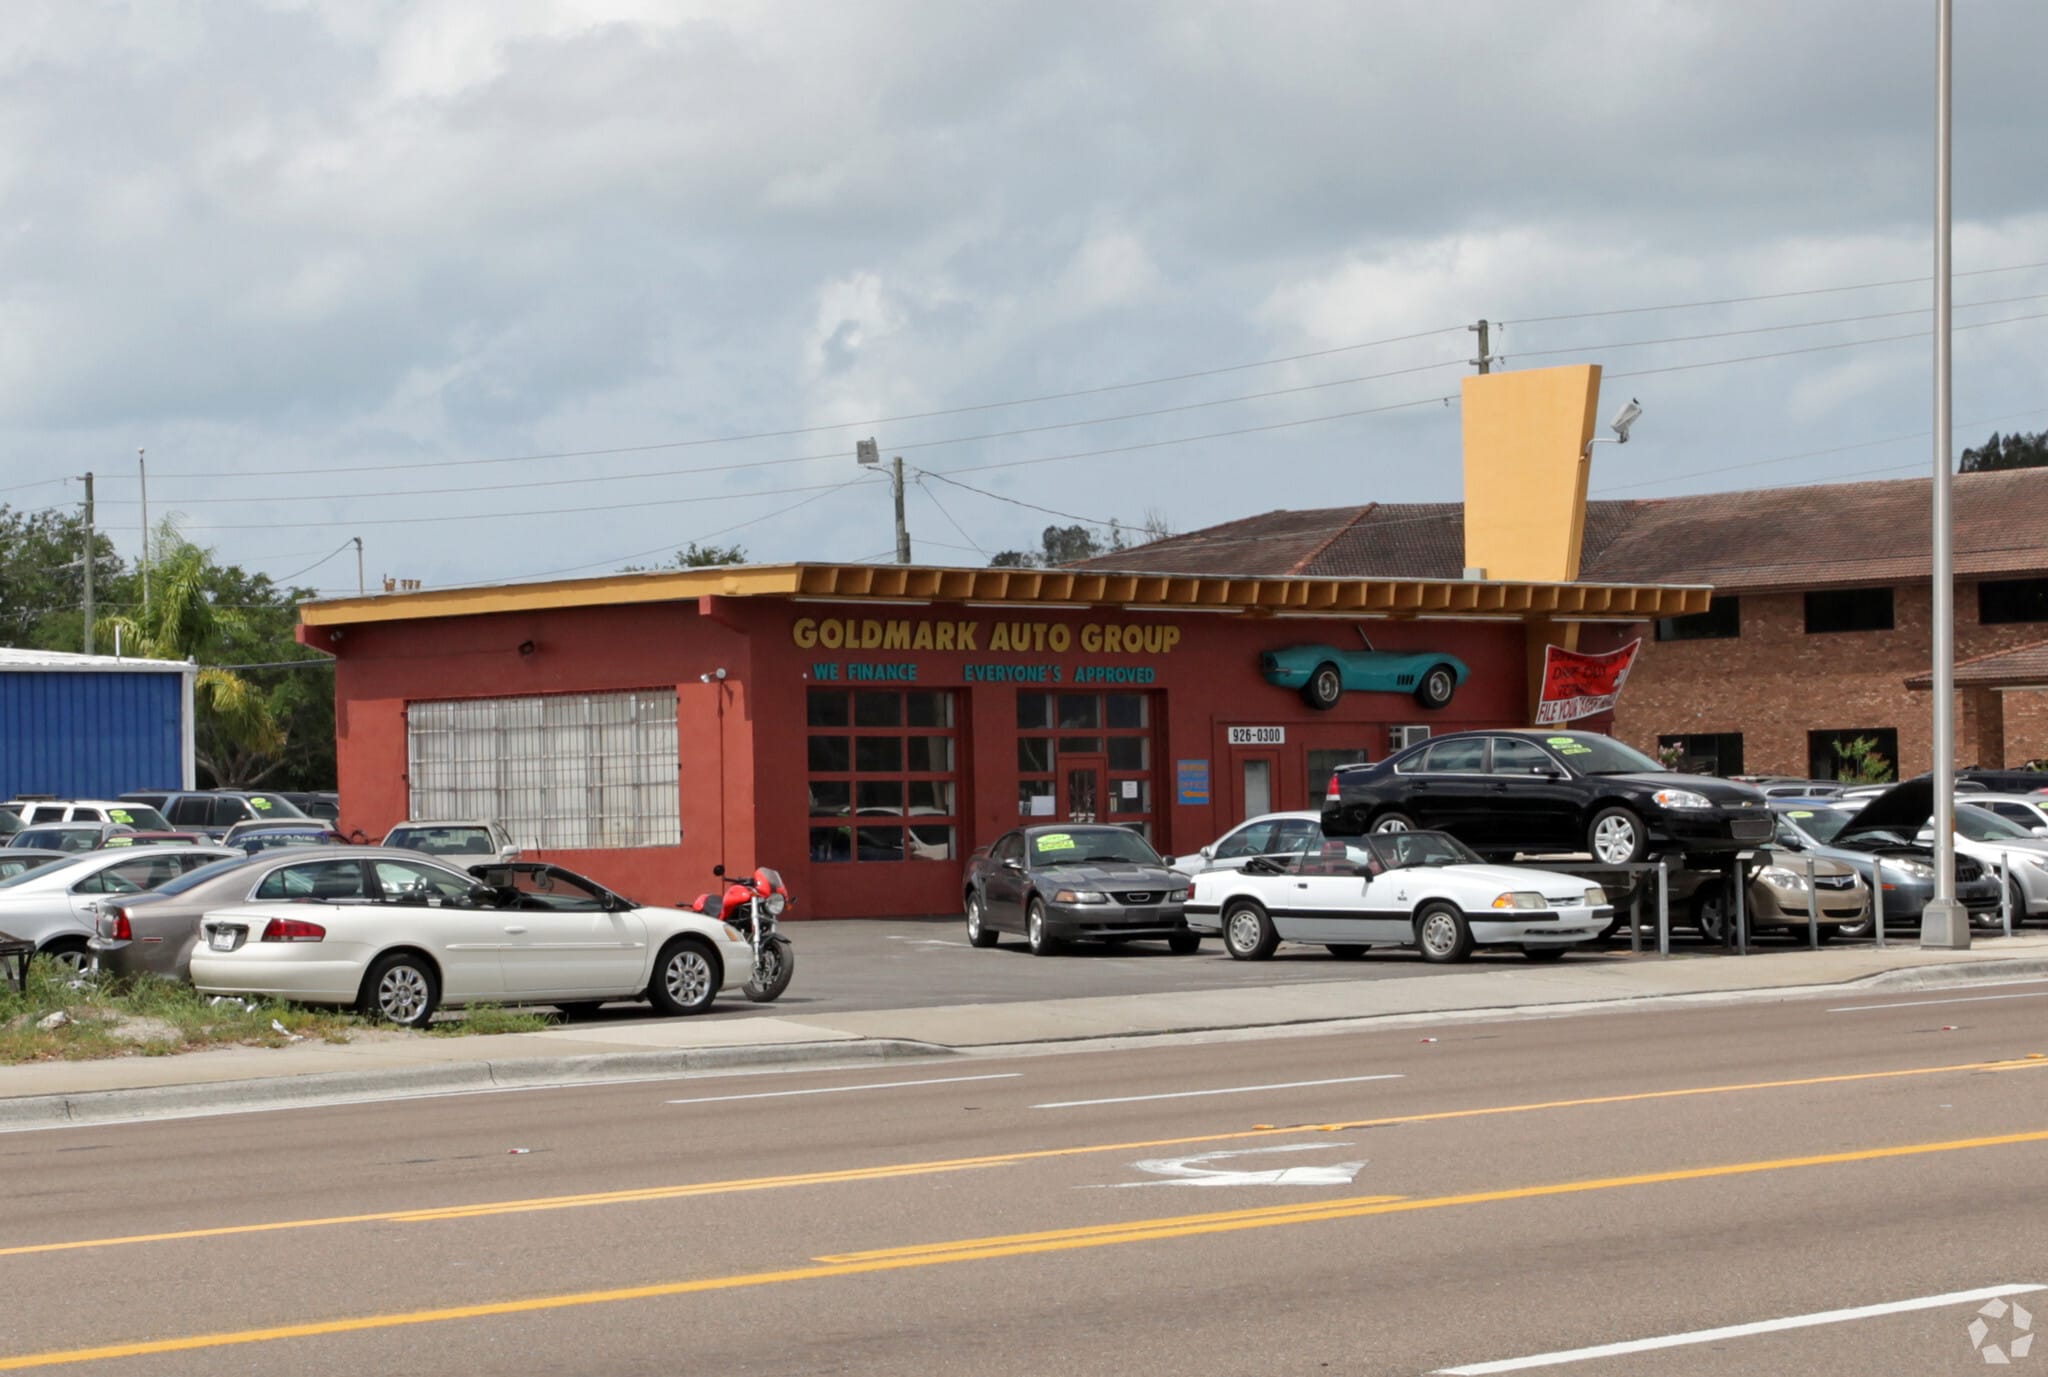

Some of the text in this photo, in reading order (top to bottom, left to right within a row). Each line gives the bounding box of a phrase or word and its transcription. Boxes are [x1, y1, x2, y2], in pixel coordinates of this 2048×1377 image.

[793, 618, 1180, 653] GOLDMARK AUTO GROUP
[813, 663, 918, 681] WE FINANCE
[963, 664, 1156, 684] EVERYONE'S APPROVED
[1538, 702, 1557, 721] FILE
[1232, 727, 1281, 743] 926-0300
